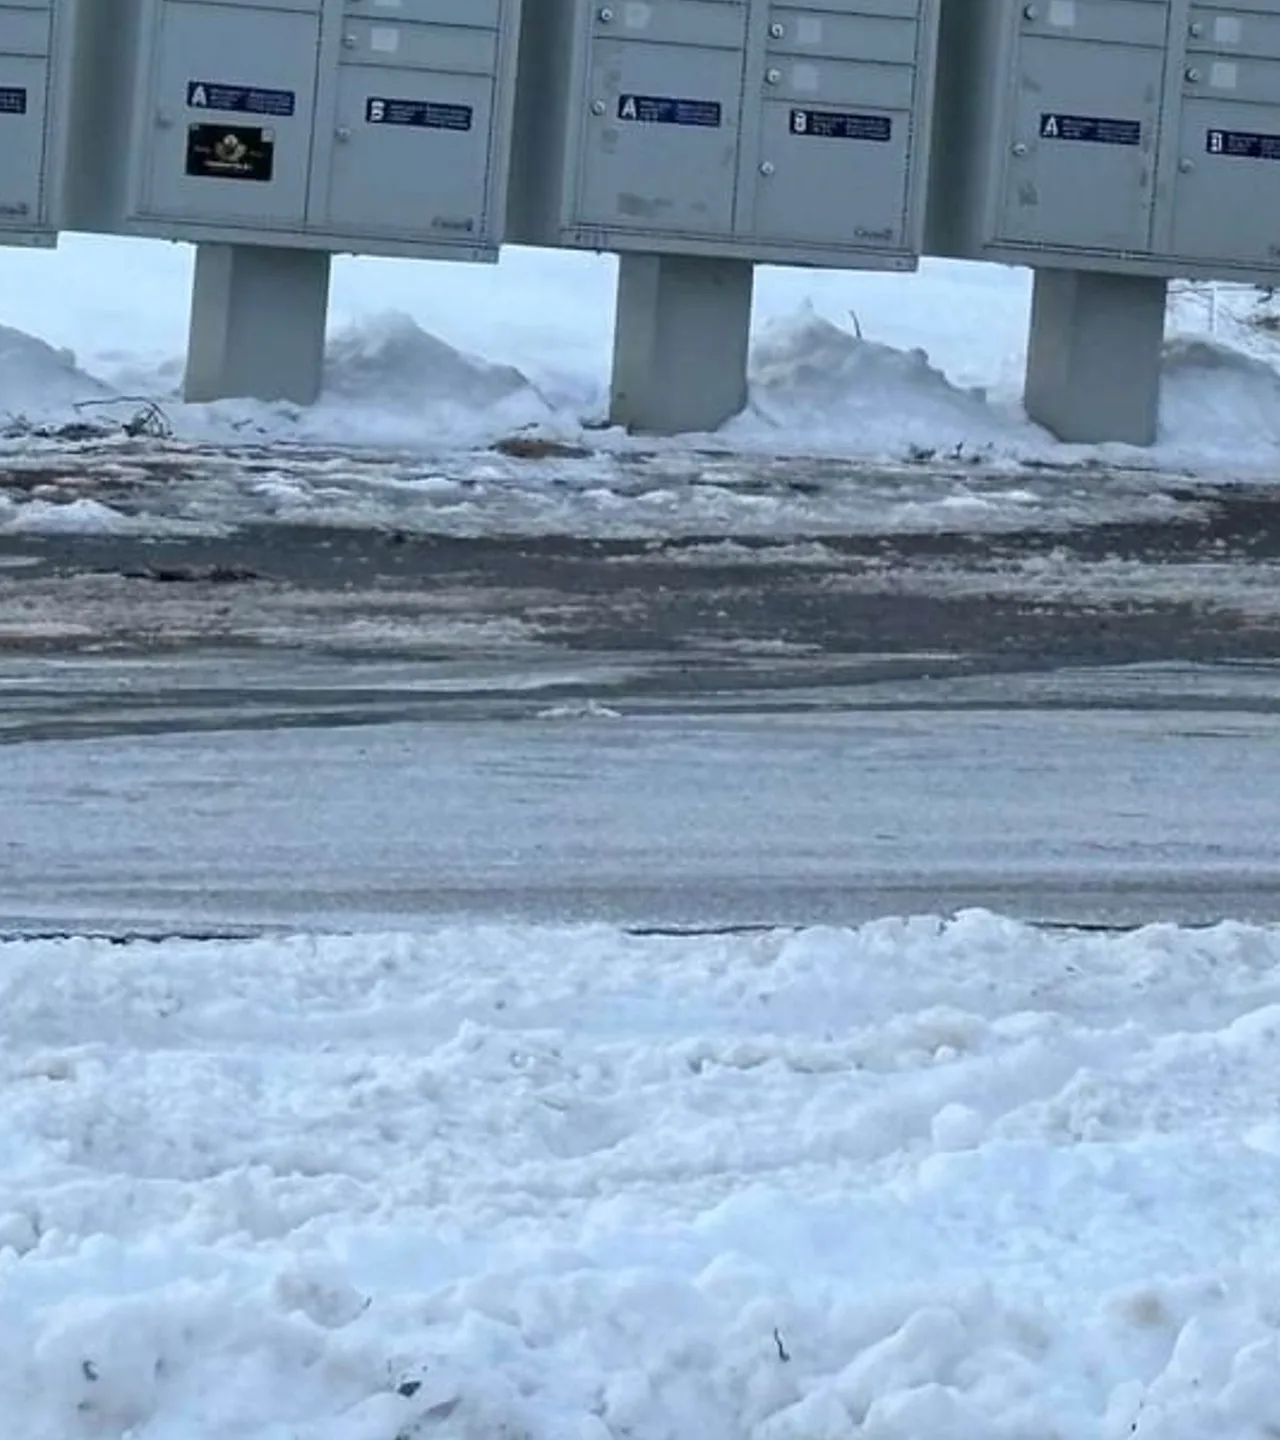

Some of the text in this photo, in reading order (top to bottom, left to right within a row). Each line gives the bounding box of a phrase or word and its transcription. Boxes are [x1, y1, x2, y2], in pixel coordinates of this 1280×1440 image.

[190, 85, 208, 107] A
[621, 98, 637, 120] A
[1042, 115, 1059, 136] A
